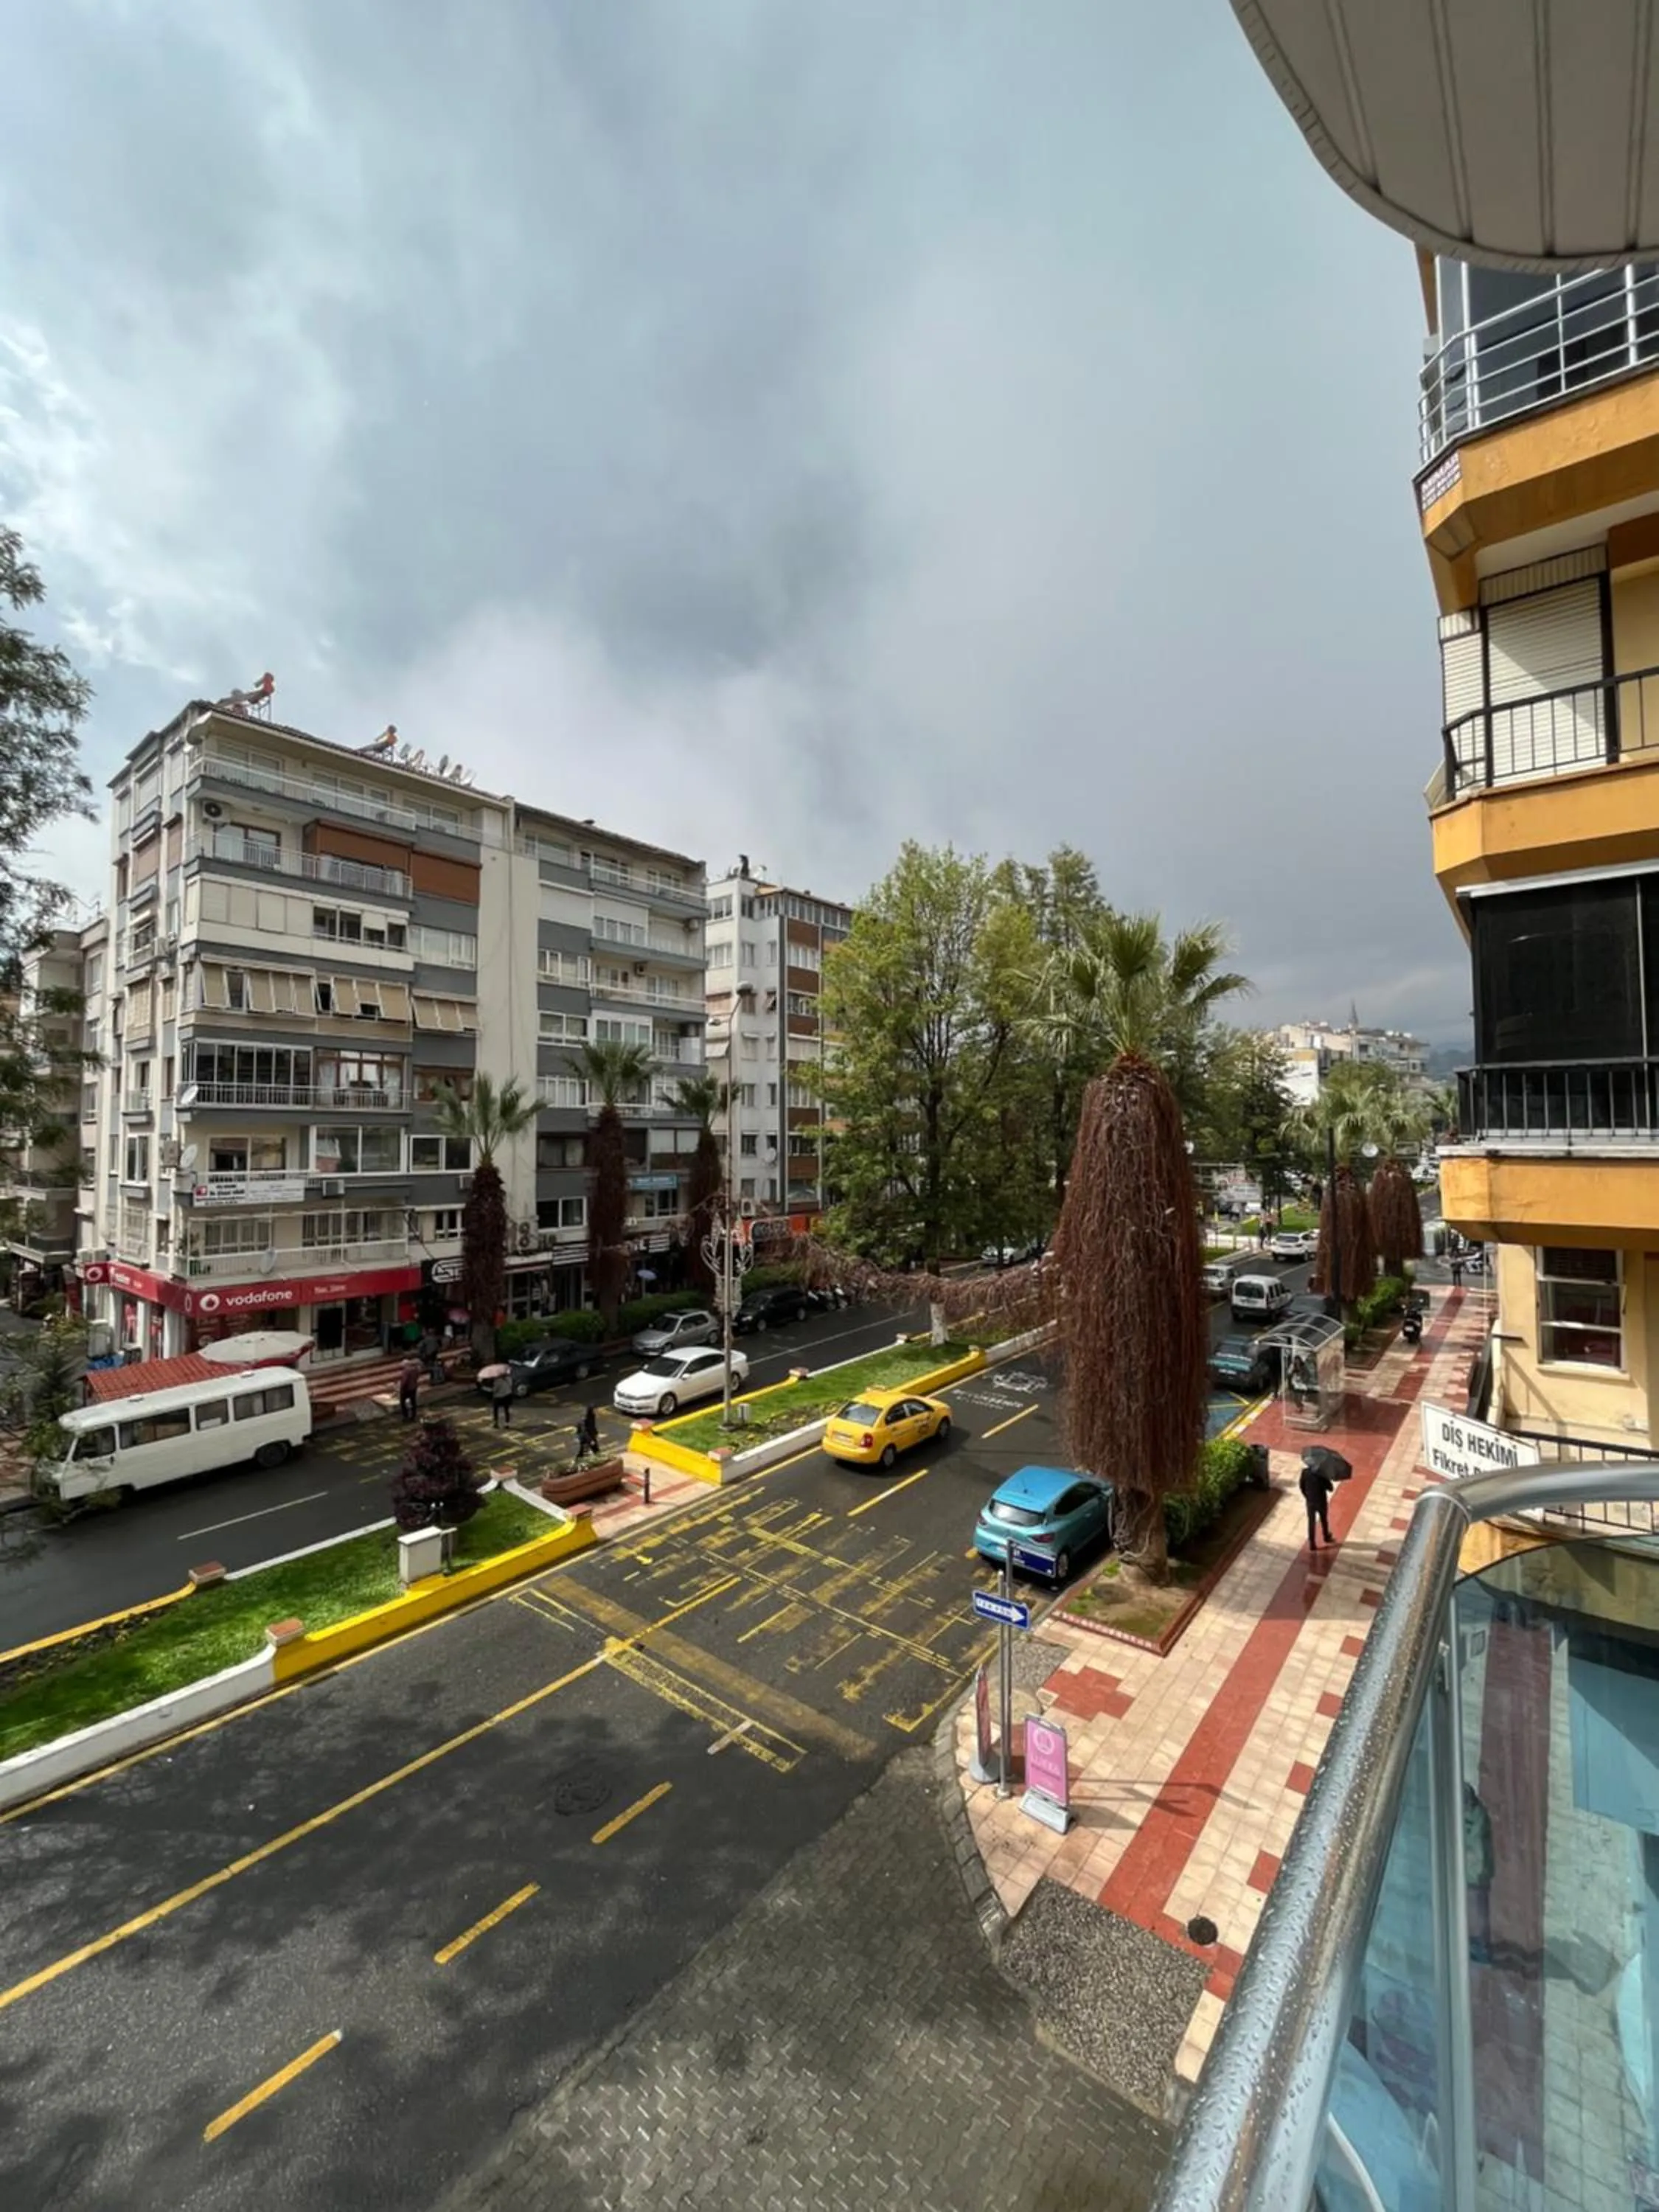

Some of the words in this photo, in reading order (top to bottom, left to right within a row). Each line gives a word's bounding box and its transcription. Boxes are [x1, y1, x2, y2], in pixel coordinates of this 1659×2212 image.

[225, 1289, 293, 1307] vodafone
[1441, 1420, 1464, 1453] DİŞ
[1467, 1433, 1518, 1467] HEKİMİ
